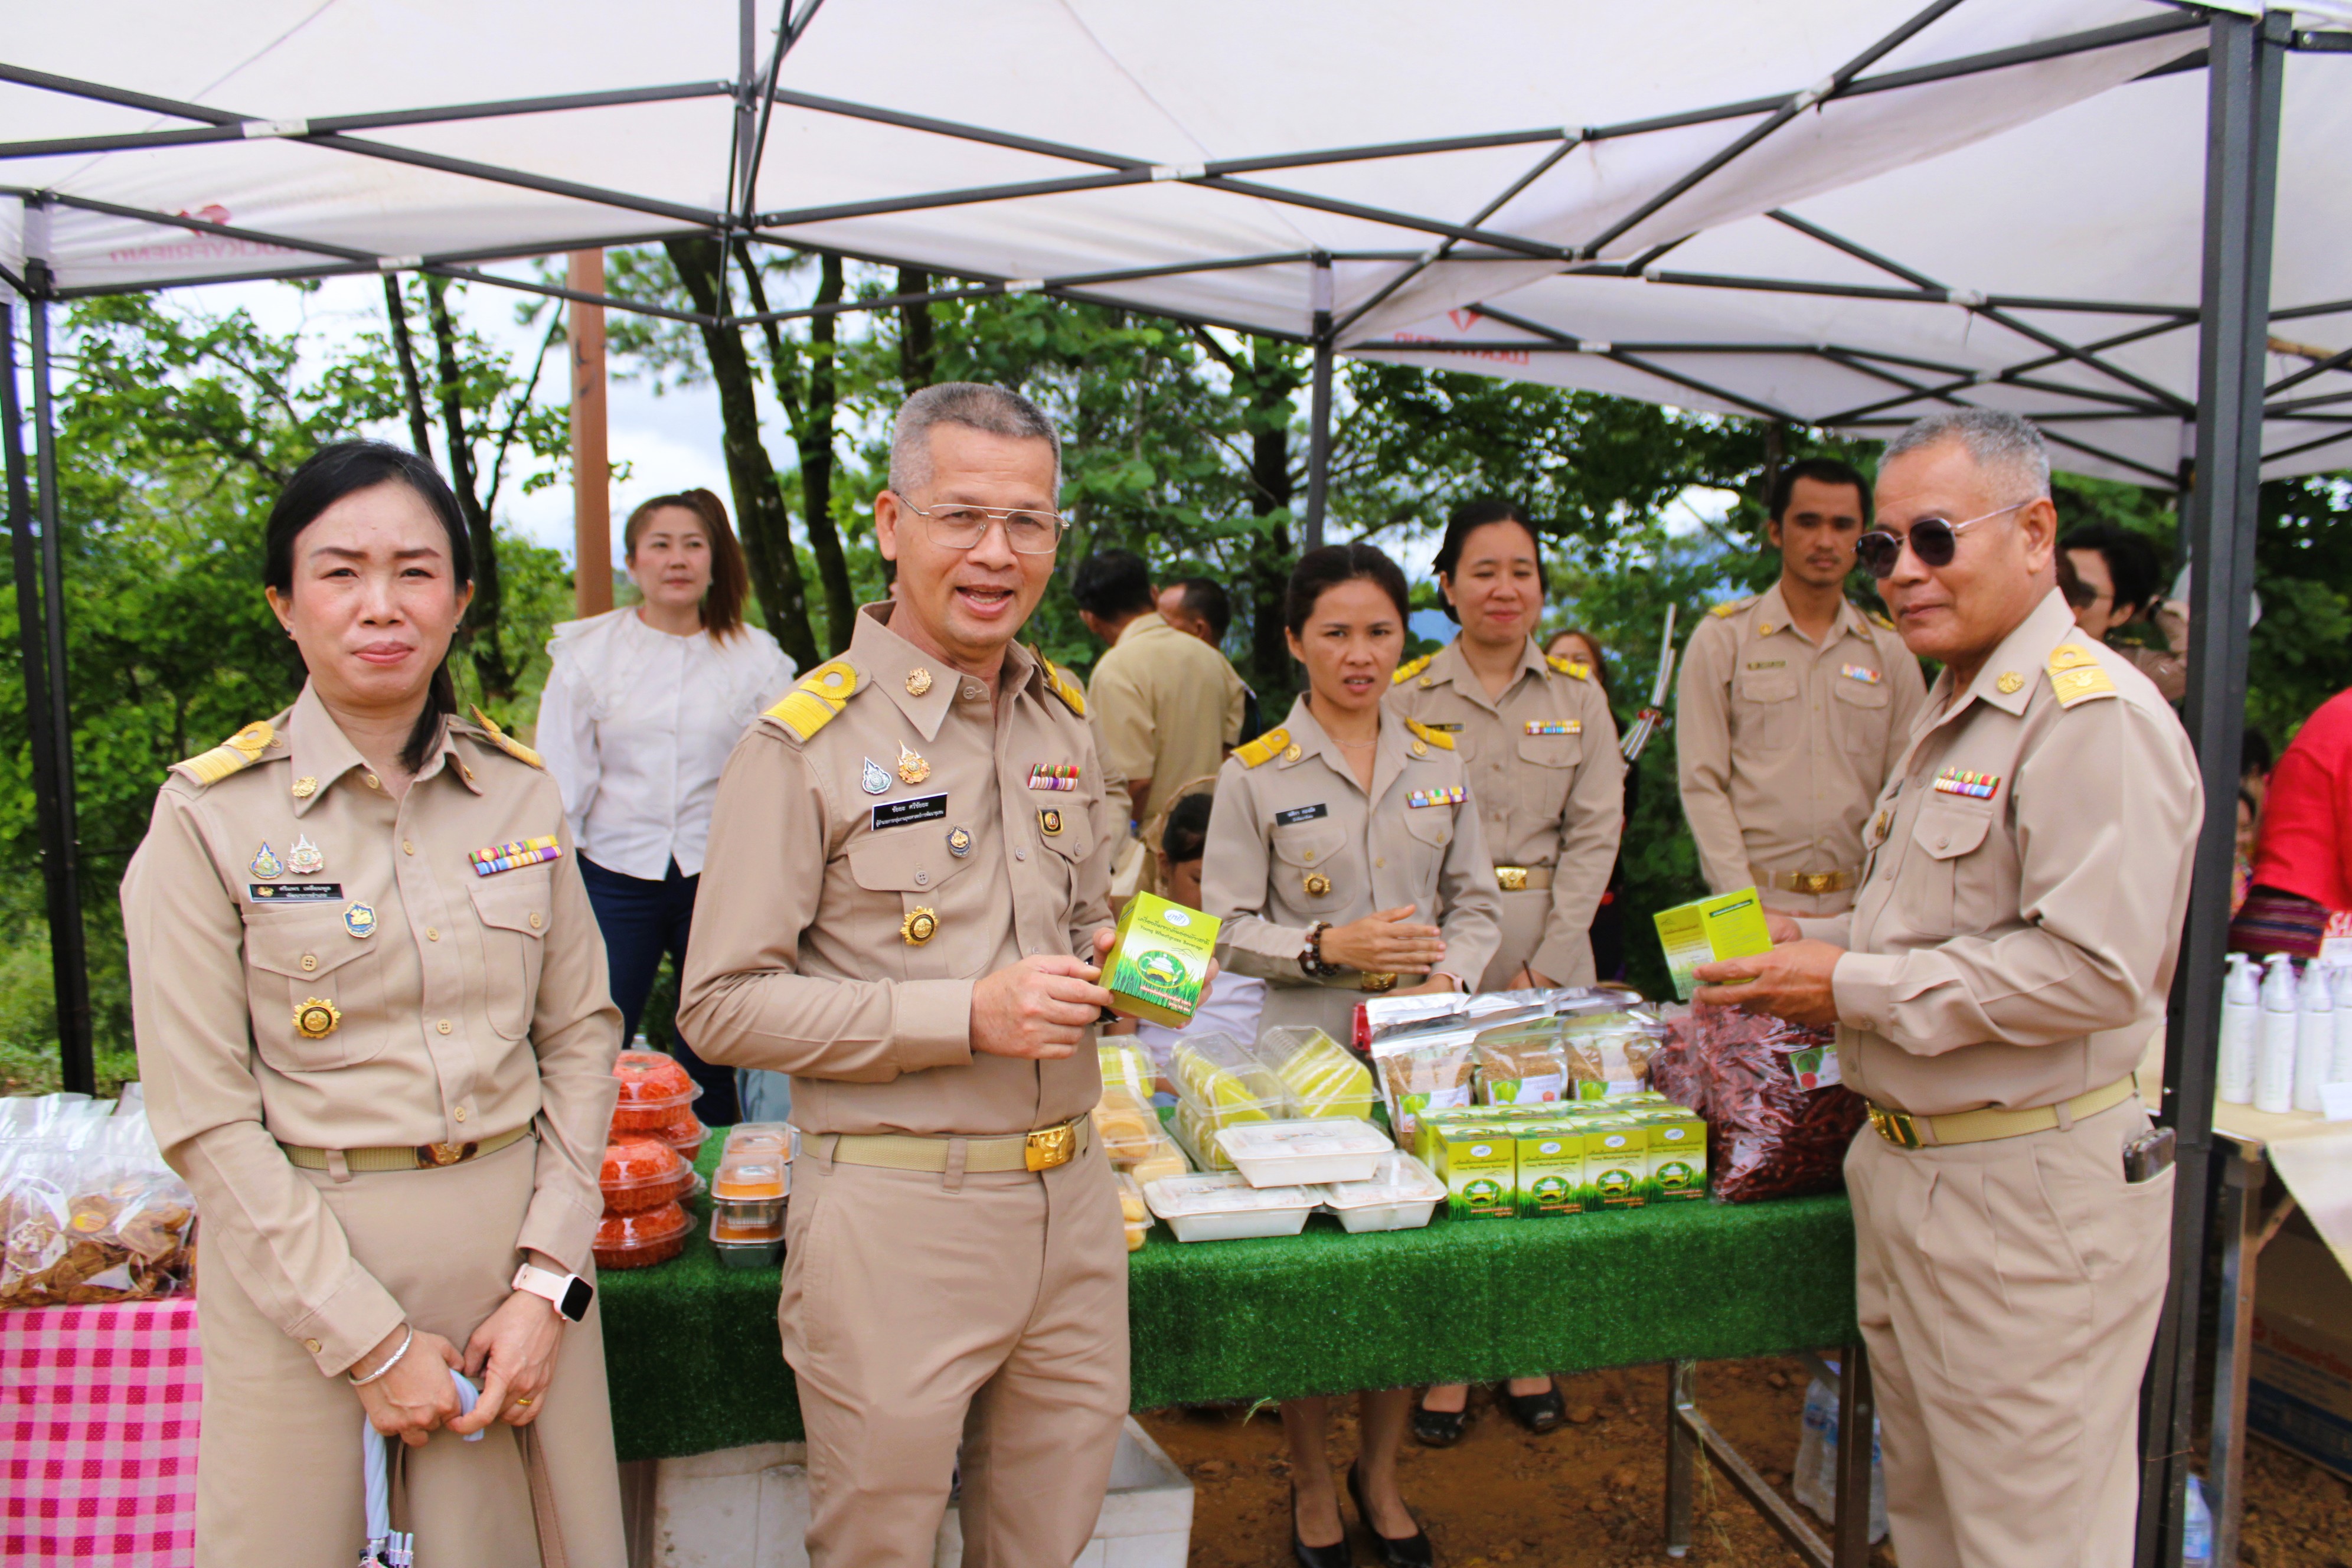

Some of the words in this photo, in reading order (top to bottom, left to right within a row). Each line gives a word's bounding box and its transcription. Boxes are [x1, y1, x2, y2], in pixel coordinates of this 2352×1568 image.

[1140, 925, 1154, 935] Young
[1155, 930, 1182, 944] Wheatgrass
[1183, 940, 1204, 951] Beverage
